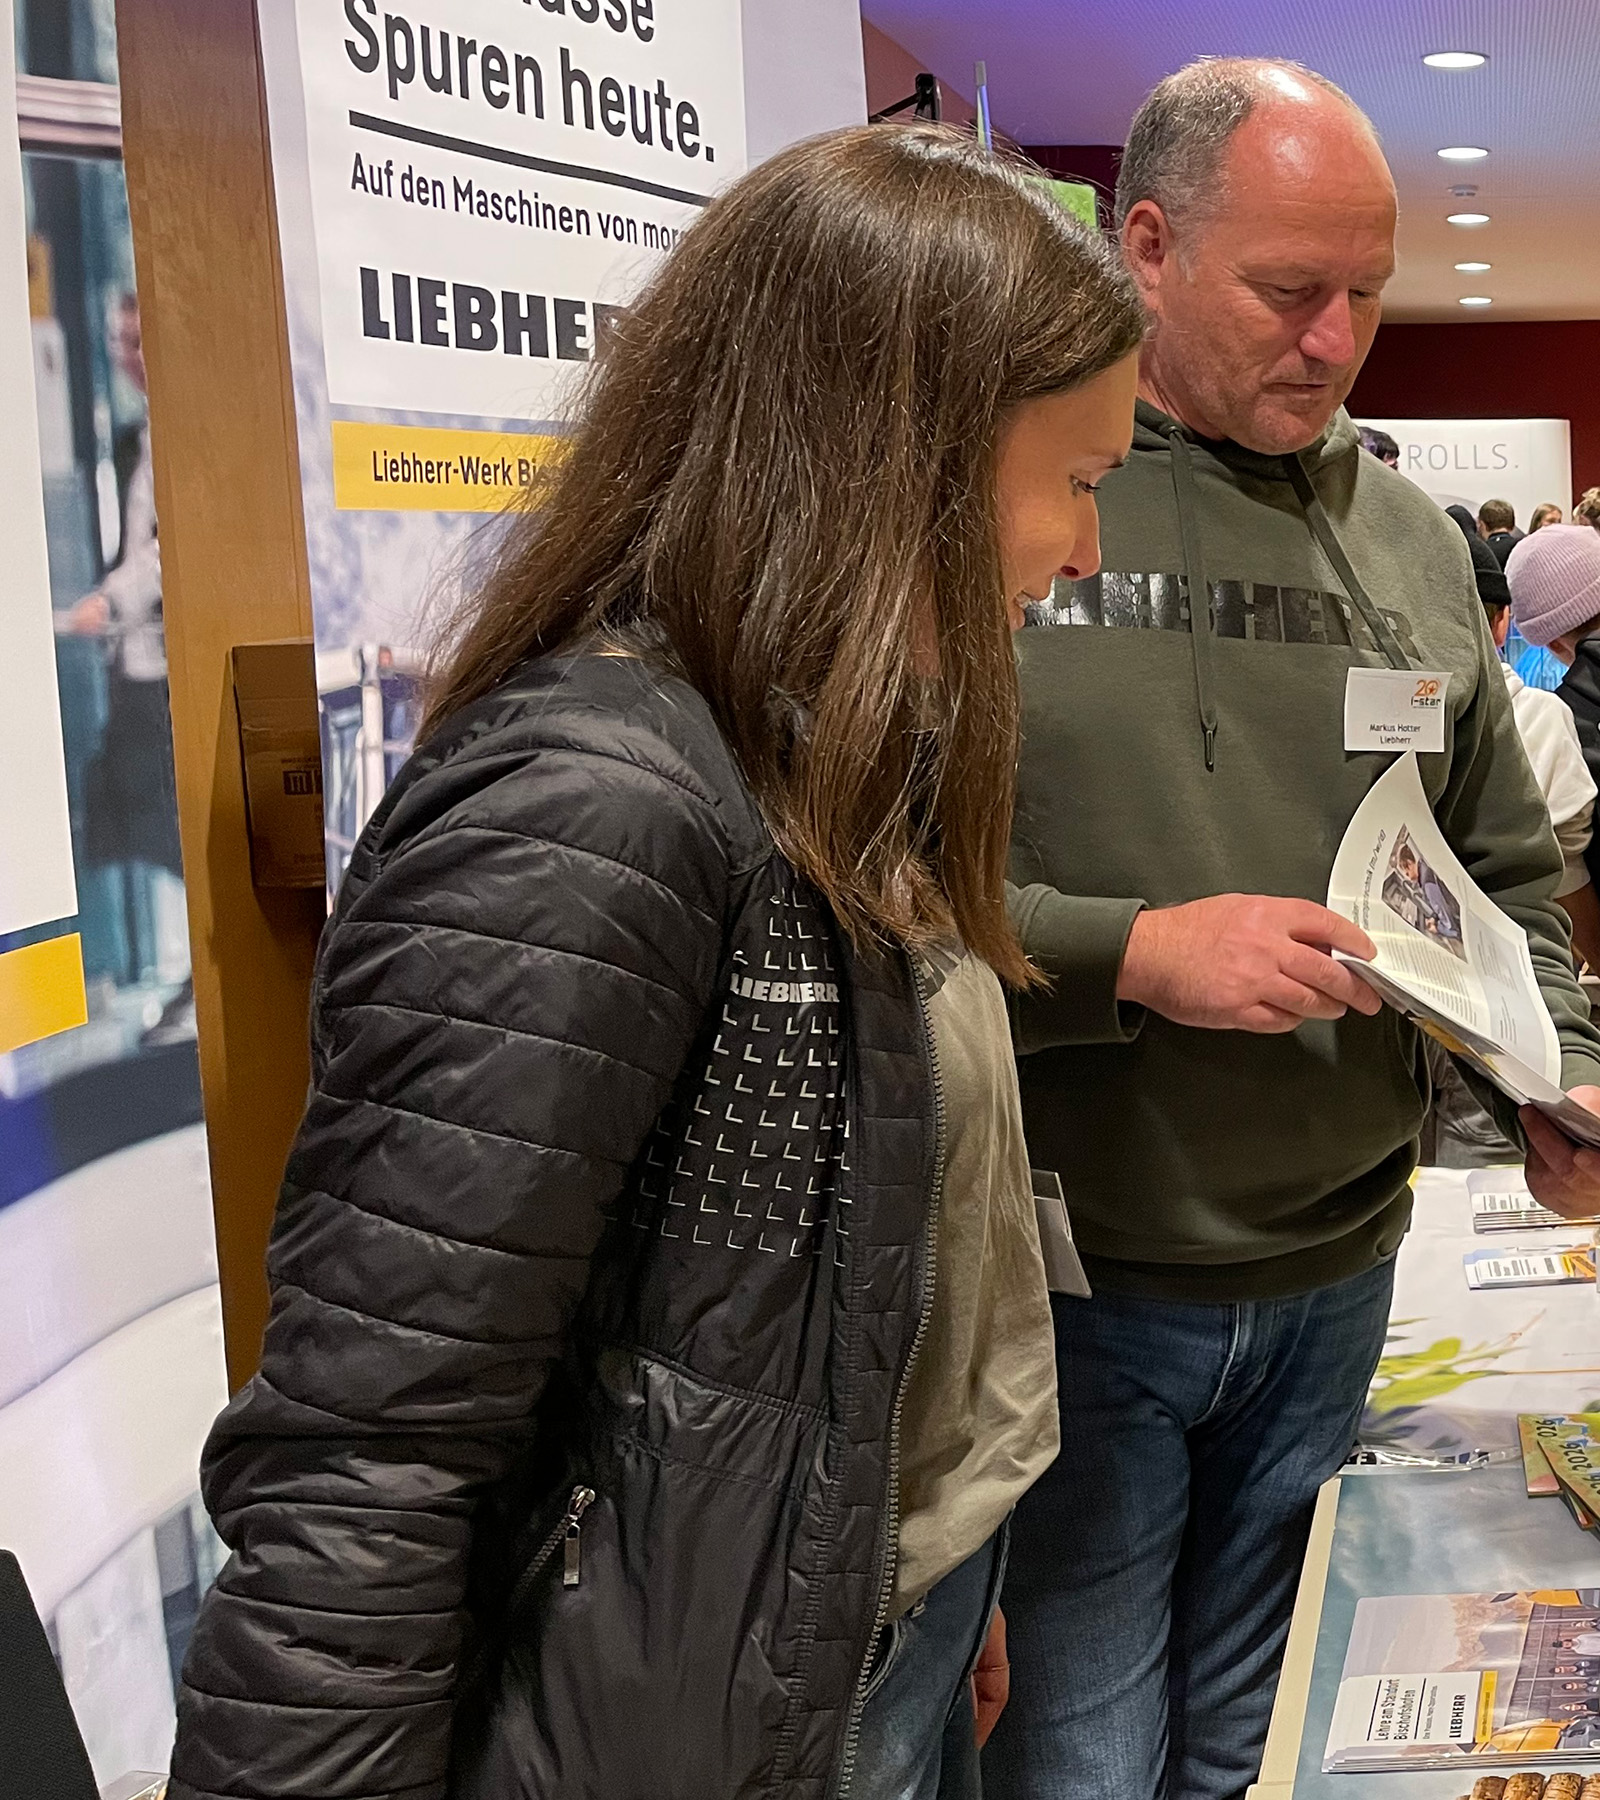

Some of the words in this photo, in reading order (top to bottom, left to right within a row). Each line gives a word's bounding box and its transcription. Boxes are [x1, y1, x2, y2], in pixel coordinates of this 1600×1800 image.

[344, 0, 545, 119] Spuren
[560, 47, 715, 162] heute.
[350, 153, 393, 197] Auf
[400, 165, 446, 209] den
[453, 176, 590, 236] Maschinen
[597, 212, 637, 244] von
[373, 450, 513, 486] Liebherr-Werk
[1407, 443, 1519, 471] ROLLS.
[1369, 723, 1396, 733] Markus
[1380, 735, 1412, 744] Liebherr
[729, 972, 841, 1003] LIEBHERR
[1535, 1420, 1558, 1438] 026
[1559, 1441, 1593, 1471] 2026
[1374, 1717, 1392, 1741] Lehre
[1449, 1694, 1466, 1739] LIEBHERR
